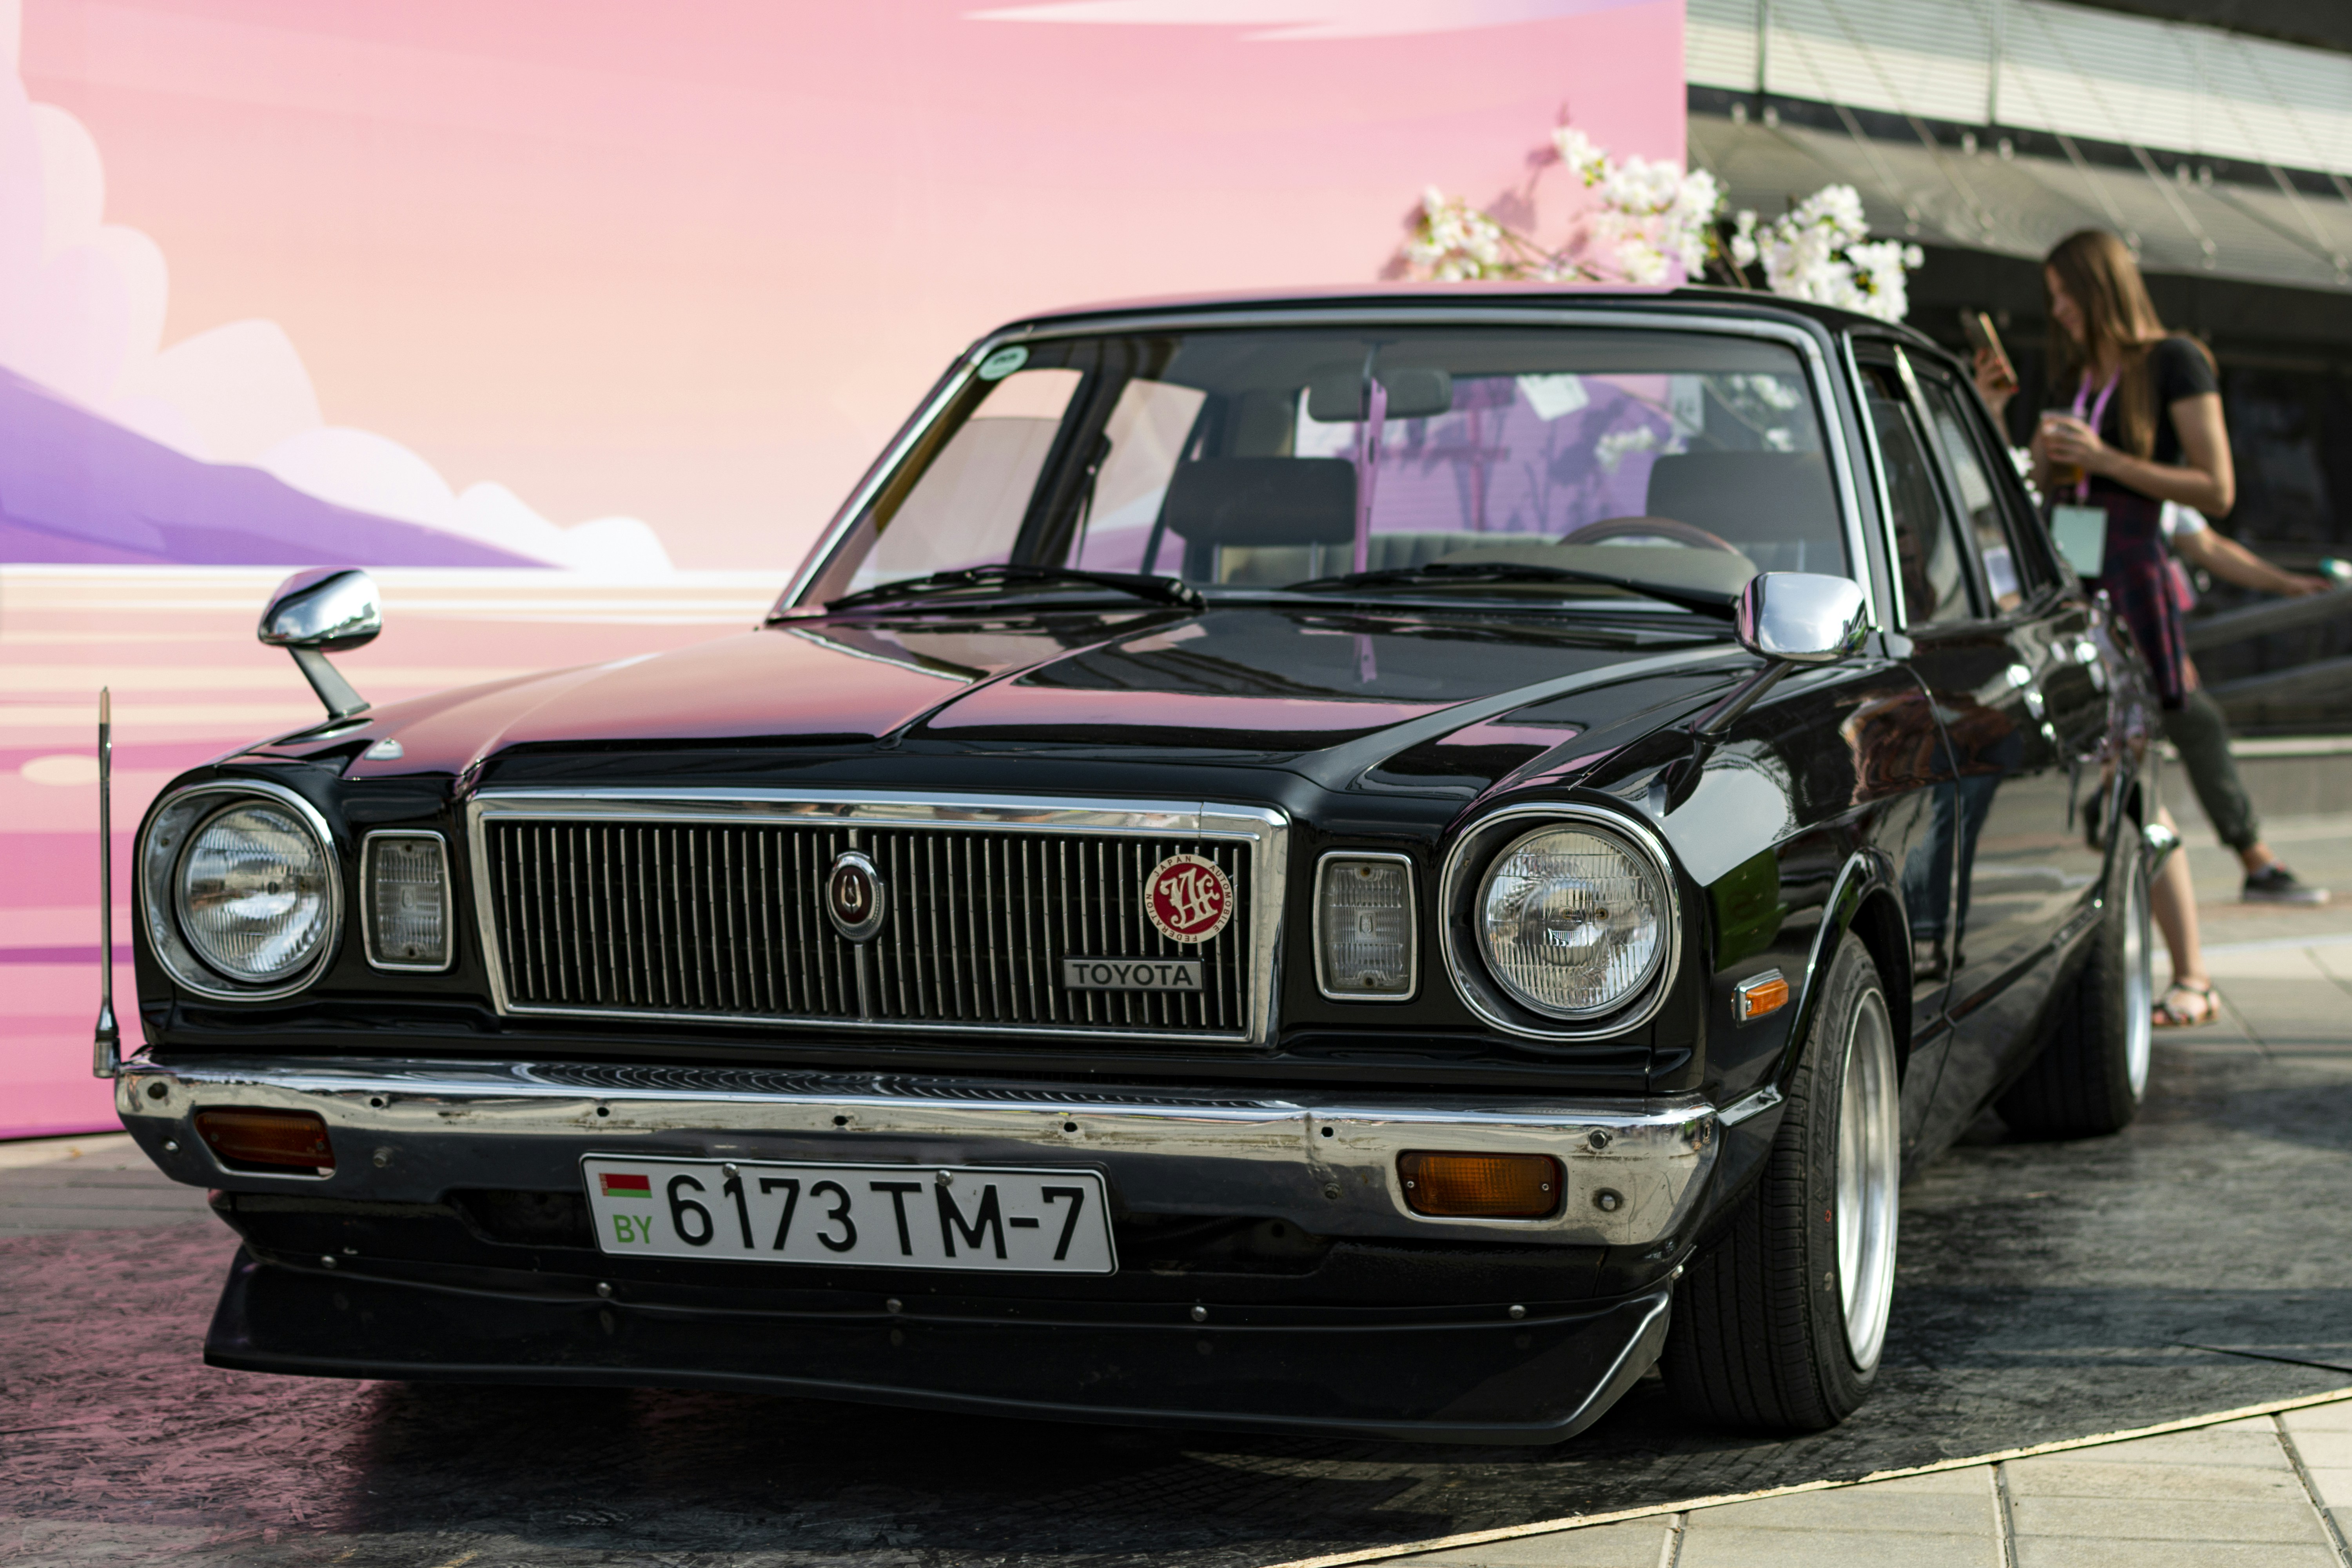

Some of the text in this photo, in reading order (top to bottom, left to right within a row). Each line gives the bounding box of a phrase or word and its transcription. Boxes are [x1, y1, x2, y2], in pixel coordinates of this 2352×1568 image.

[1146, 855, 1232, 942] JAPAN AUTOMOBILE FEDERATION
[1072, 964, 1193, 985] TOYOTA
[612, 1214, 653, 1244] BY
[666, 1174, 1085, 1261] 6173 TM-7
